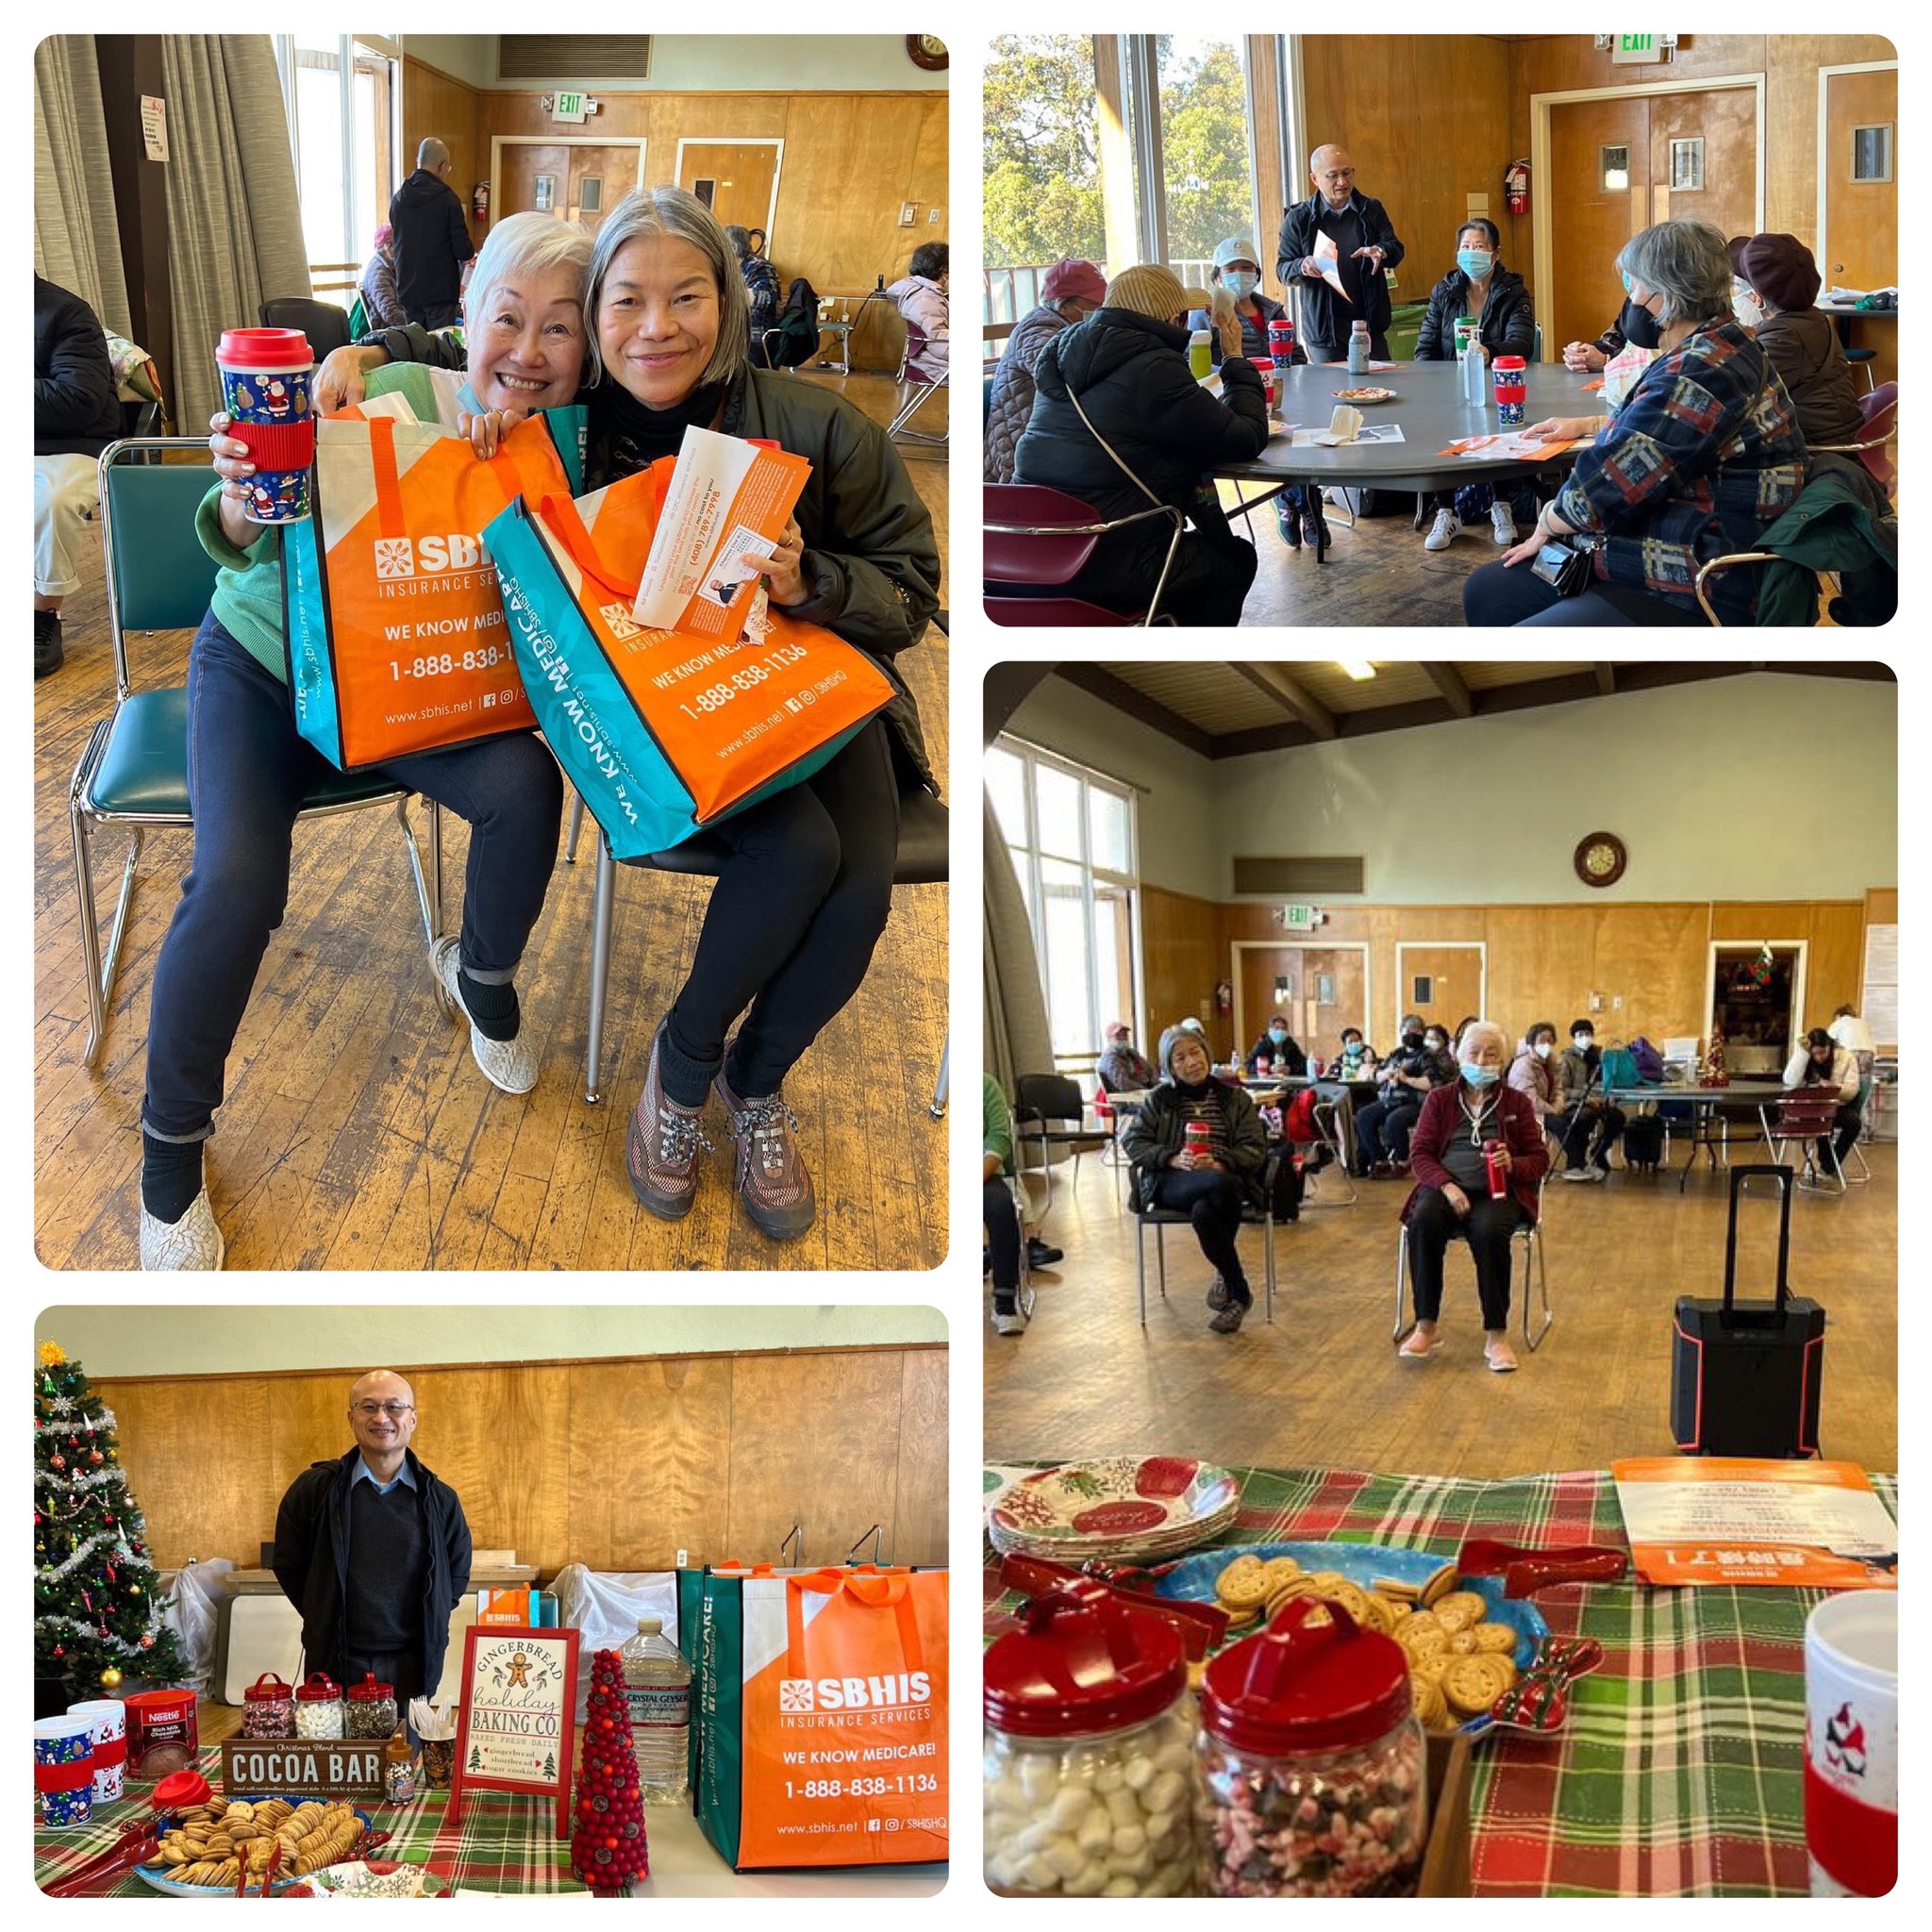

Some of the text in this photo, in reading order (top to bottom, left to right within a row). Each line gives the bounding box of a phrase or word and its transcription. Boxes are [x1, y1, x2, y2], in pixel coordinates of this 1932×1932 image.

[1623, 34, 1652, 51] EXIT
[559, 94, 581, 113] EXIT
[694, 514, 702, 525] no
[698, 499, 707, 514] cost
[688, 490, 721, 566] (408) 789-7998
[704, 510, 720, 548] www.sbhis.net
[378, 576, 471, 599] INSURANCE
[507, 575, 543, 628] SBHISHQ
[384, 625, 411, 641] WE
[416, 616, 469, 638] KNOW
[390, 641, 513, 681] 1-888-838-1
[651, 671, 676, 690] WE
[672, 652, 715, 680] KNOW
[679, 643, 808, 721] 1-888-838-1136
[385, 699, 474, 724] www.sbhis.net
[716, 709, 785, 759] www.sbhis.net
[814, 670, 848, 694] SBHISHQ
[560, 694, 621, 781] KNOW
[571, 685, 638, 783] www.sbhis.net
[614, 783, 640, 825] WE
[477, 1641, 563, 1680] GINGERBREAD
[474, 1687, 560, 1717] holiday
[627, 1694, 689, 1703] CRYSTAL GEYSER
[817, 1672, 931, 1708] SBHIS
[472, 1710, 559, 1736] BAKING CO.
[780, 1708, 931, 1728] INSURANCE SERVICES
[151, 1729, 180, 1738] Chocolate
[501, 1737, 526, 1745] FRESH
[532, 1740, 558, 1748] DAILY
[276, 1743, 334, 1752] Christmas Blend
[489, 1747, 535, 1757] gingerbread
[783, 1743, 936, 1764] WE KNOW MEDICARE!
[232, 1754, 380, 1783] COCOA BAR
[486, 1764, 538, 1775] sugar cookies
[491, 1757, 533, 1767] shortbread
[785, 1774, 937, 1799] 1-888-838-1136
[777, 1822, 858, 1834] www.sbhis.net
[908, 1816, 947, 1829] SBHISHQ
